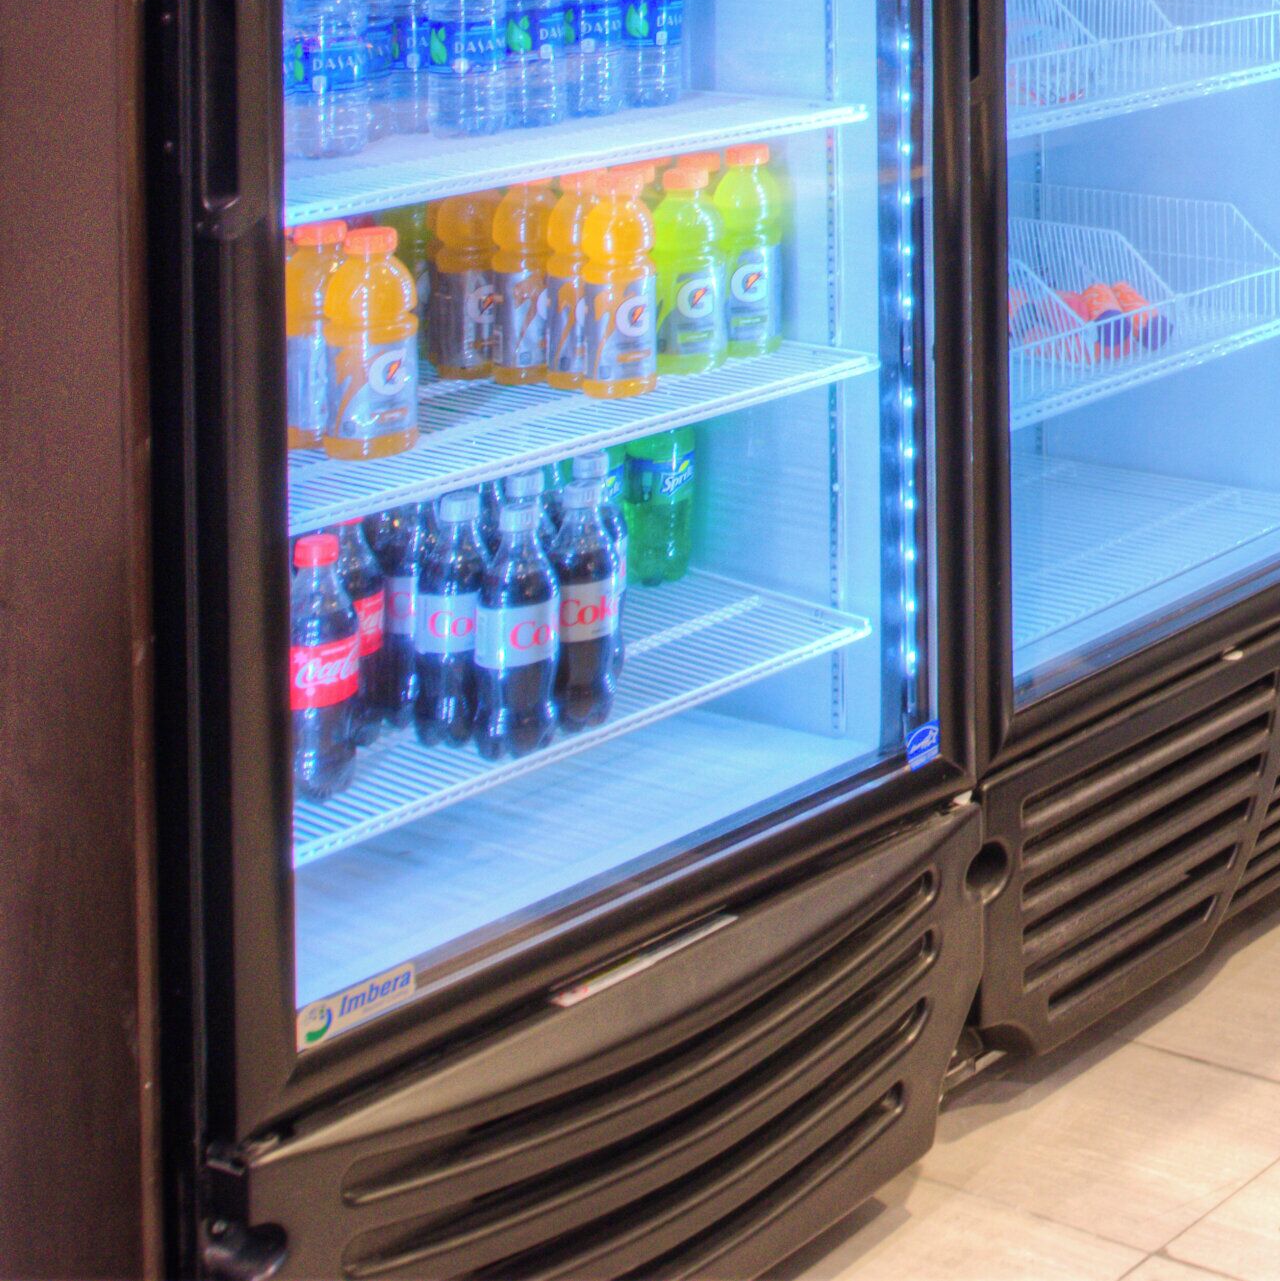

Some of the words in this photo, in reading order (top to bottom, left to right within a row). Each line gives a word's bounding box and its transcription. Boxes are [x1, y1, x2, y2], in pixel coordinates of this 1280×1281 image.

[677, 279, 715, 318] G
[730, 263, 765, 302] G
[615, 296, 650, 338] G
[369, 348, 407, 397] G
[339, 970, 412, 1018] Imbera
